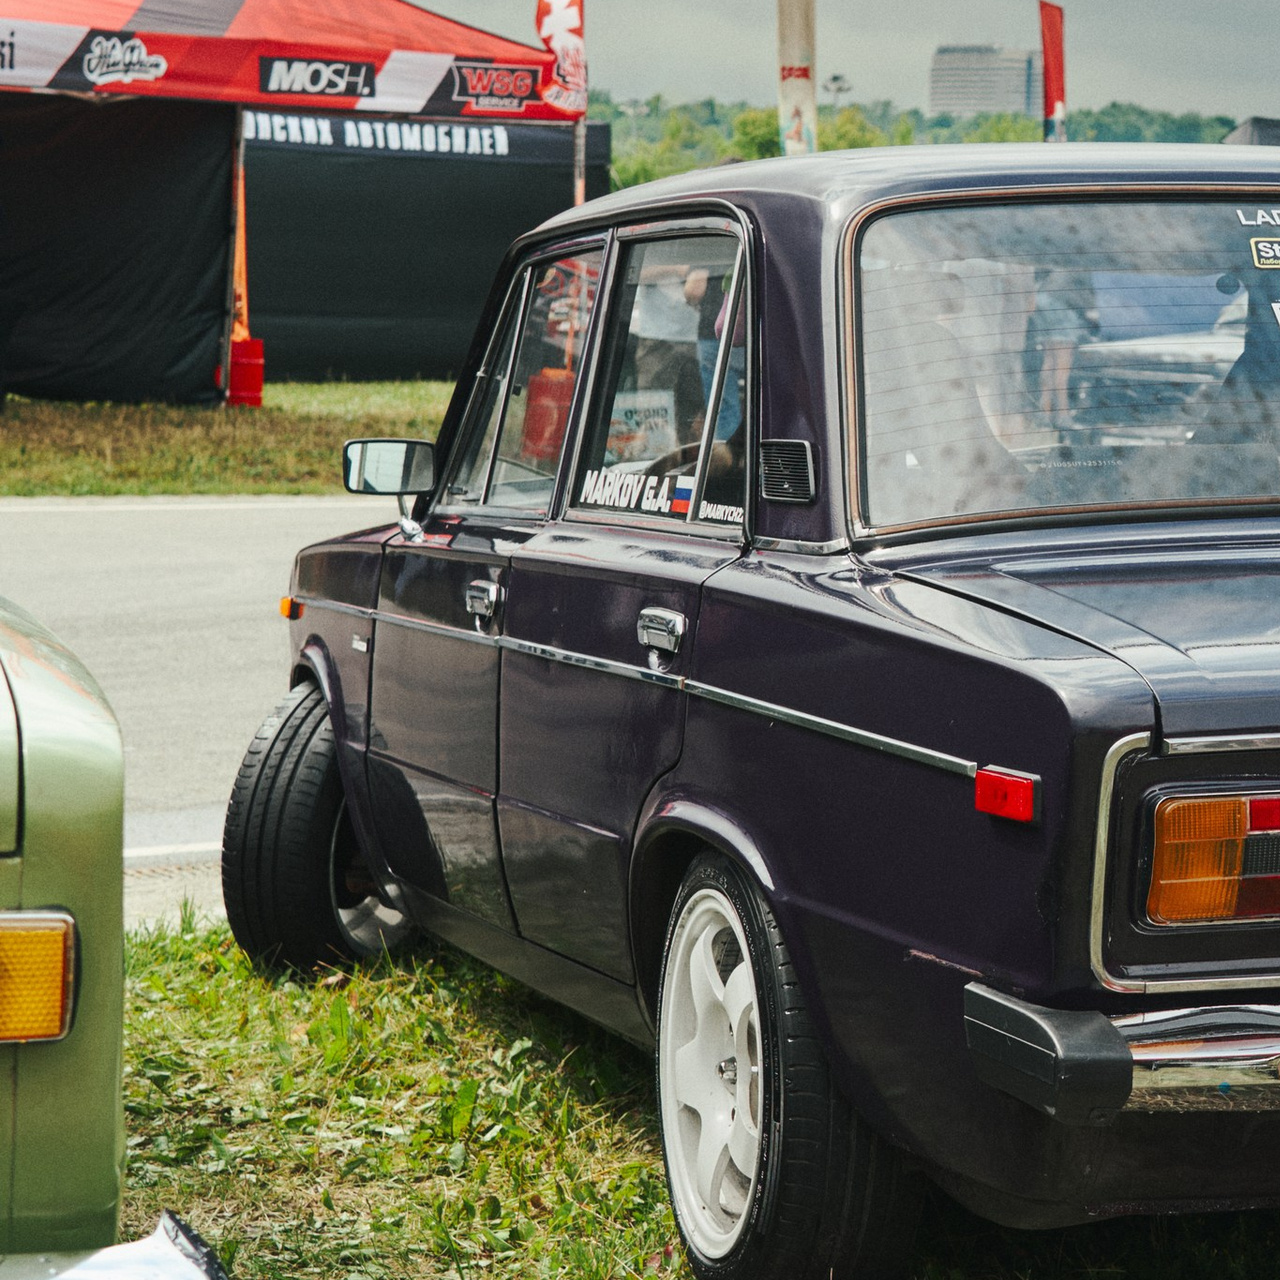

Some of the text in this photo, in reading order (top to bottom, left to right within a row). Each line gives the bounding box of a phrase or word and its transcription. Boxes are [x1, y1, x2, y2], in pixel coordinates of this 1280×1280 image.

[462, 67, 532, 97] WSG
[243, 111, 509, 155] ОНСКИХ АВТОМОБИЛЕЙ
[580, 470, 671, 513] MARKOV G.A.
